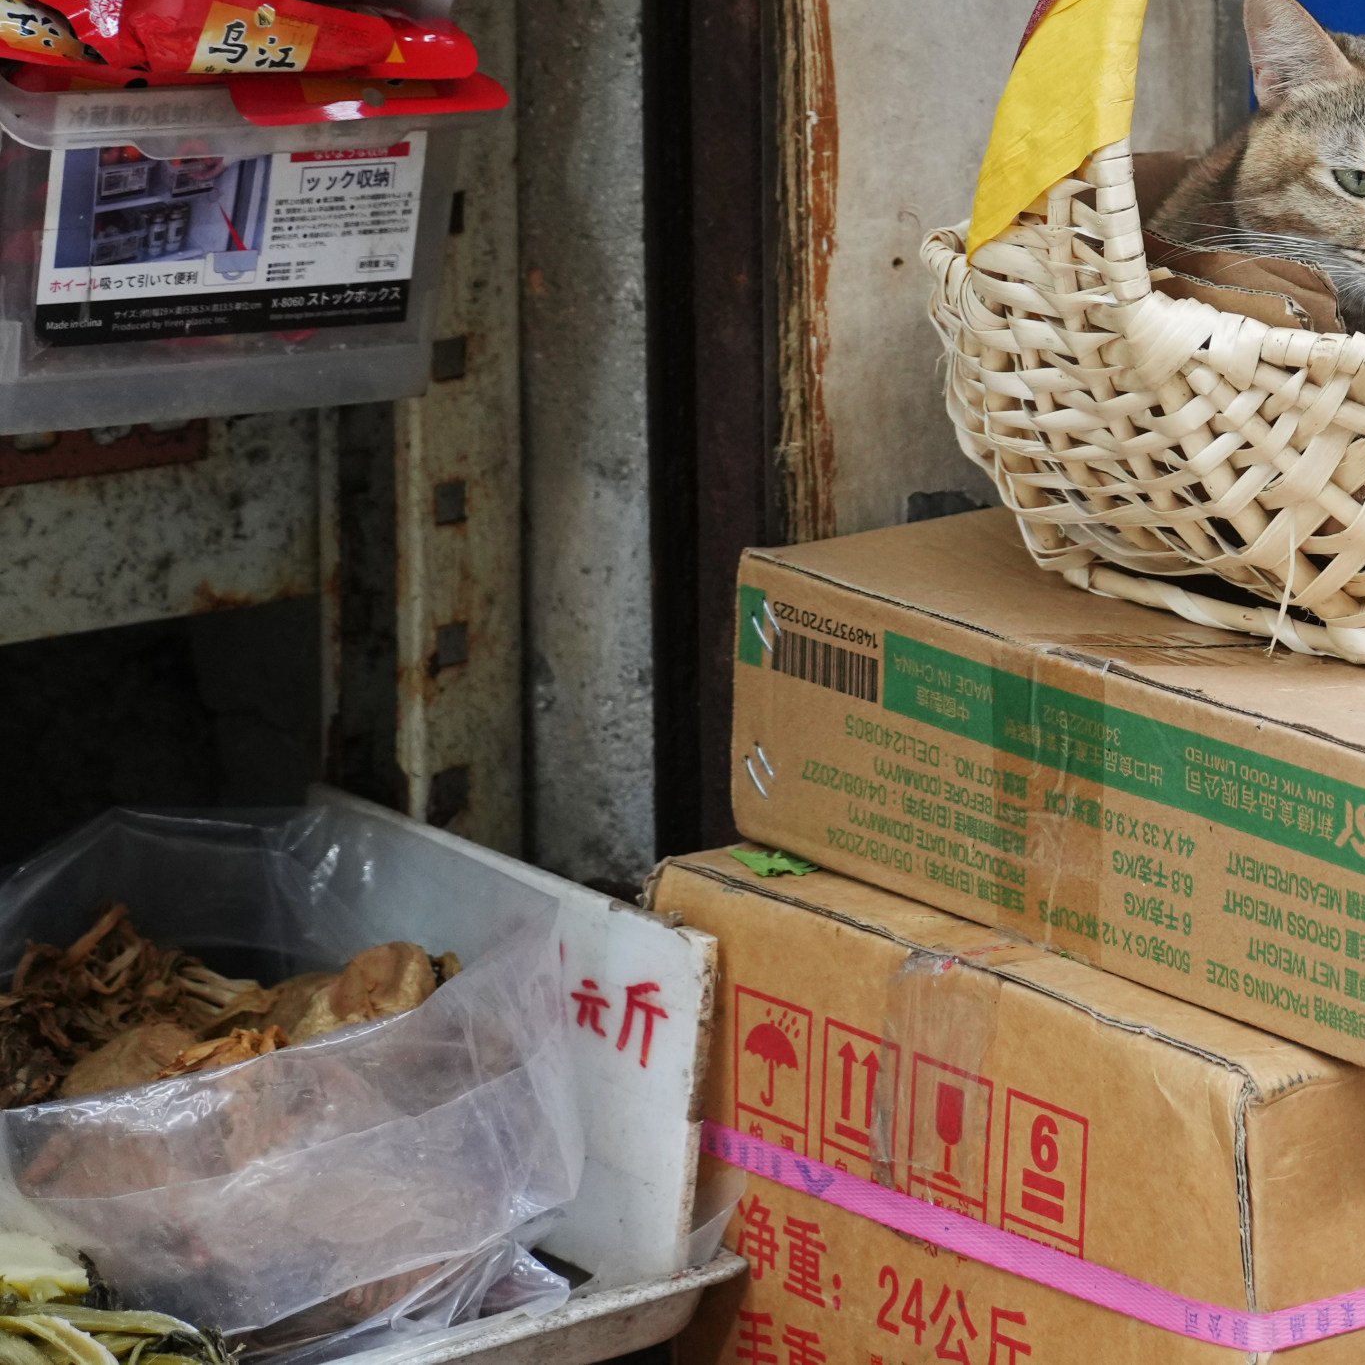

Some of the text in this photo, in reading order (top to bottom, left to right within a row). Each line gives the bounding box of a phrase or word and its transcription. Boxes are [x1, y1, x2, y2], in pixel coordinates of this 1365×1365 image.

[207, 19, 296, 69] 乌江
[46, 320, 69, 331] Made
[773, 600, 879, 650] 14893757201225
[893, 653, 936, 681] CHINA
[955, 674, 993, 701] MADE
[802, 759, 888, 805] 04/08/2027
[945, 781, 993, 814] BEFORE
[1184, 746, 1335, 809] SUN YIK FOOD LIMITED
[1184, 766, 1334, 841] 新億食品有限公司
[827, 825, 913, 873] 05/08/2024
[916, 828, 945, 856] DATE
[1142, 819, 1160, 848] 33
[1226, 850, 1342, 915] MEASUREMENT
[1182, 912, 1192, 936] 6
[1223, 889, 1283, 931] WEIGHT
[1286, 911, 1342, 952] GROSS
[1206, 959, 1239, 993] SIZE
[1246, 936, 1306, 979] WEIGHT
[1310, 959, 1341, 990] NET
[1243, 973, 1310, 1019] PACKING
[1031, 1114, 1059, 1173] 6
